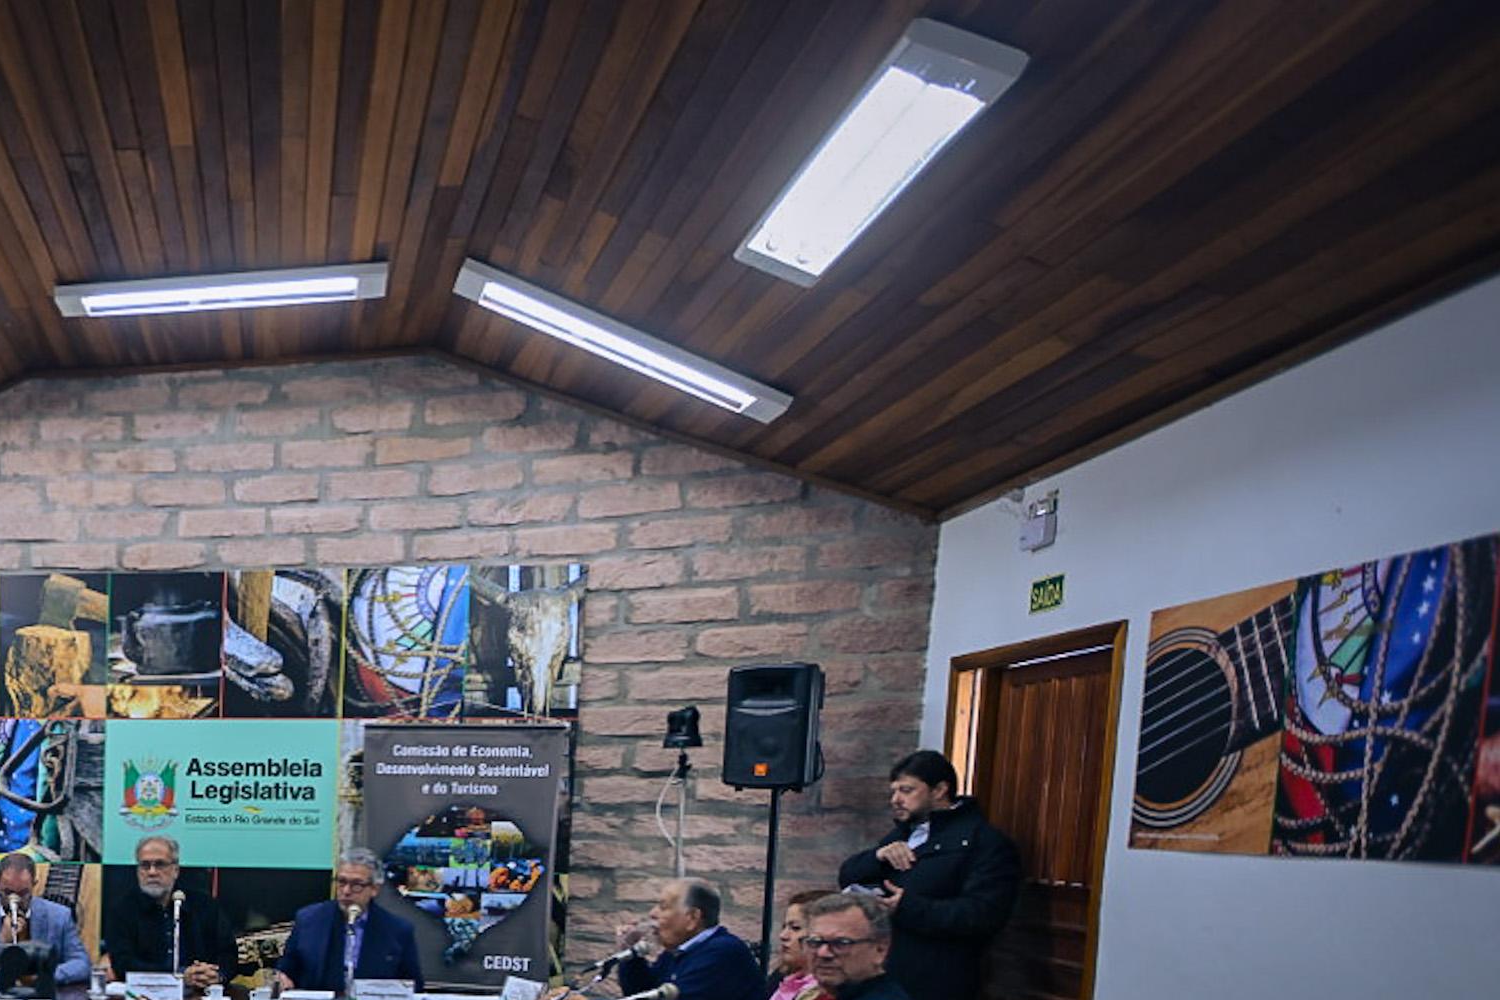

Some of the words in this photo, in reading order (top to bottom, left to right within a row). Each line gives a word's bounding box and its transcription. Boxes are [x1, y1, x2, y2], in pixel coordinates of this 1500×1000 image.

[393, 745, 449, 757] Comissão
[452, 745, 467, 757] de
[470, 745, 533, 759] Economia,
[186, 758, 322, 777] Assembleia
[376, 762, 475, 776] Desenvolvimento
[478, 763, 550, 777] Sustentável
[191, 780, 315, 804] Legislativa
[421, 784, 430, 794] e
[433, 782, 448, 794] do
[451, 781, 498, 795] Turismo
[185, 814, 218, 824] Estado
[219, 814, 232, 824] do
[235, 814, 249, 824] Rio
[251, 815, 286, 825] Grande
[289, 815, 302, 825] do
[304, 816, 319, 826] Sul
[484, 955, 531, 971] CEDST
